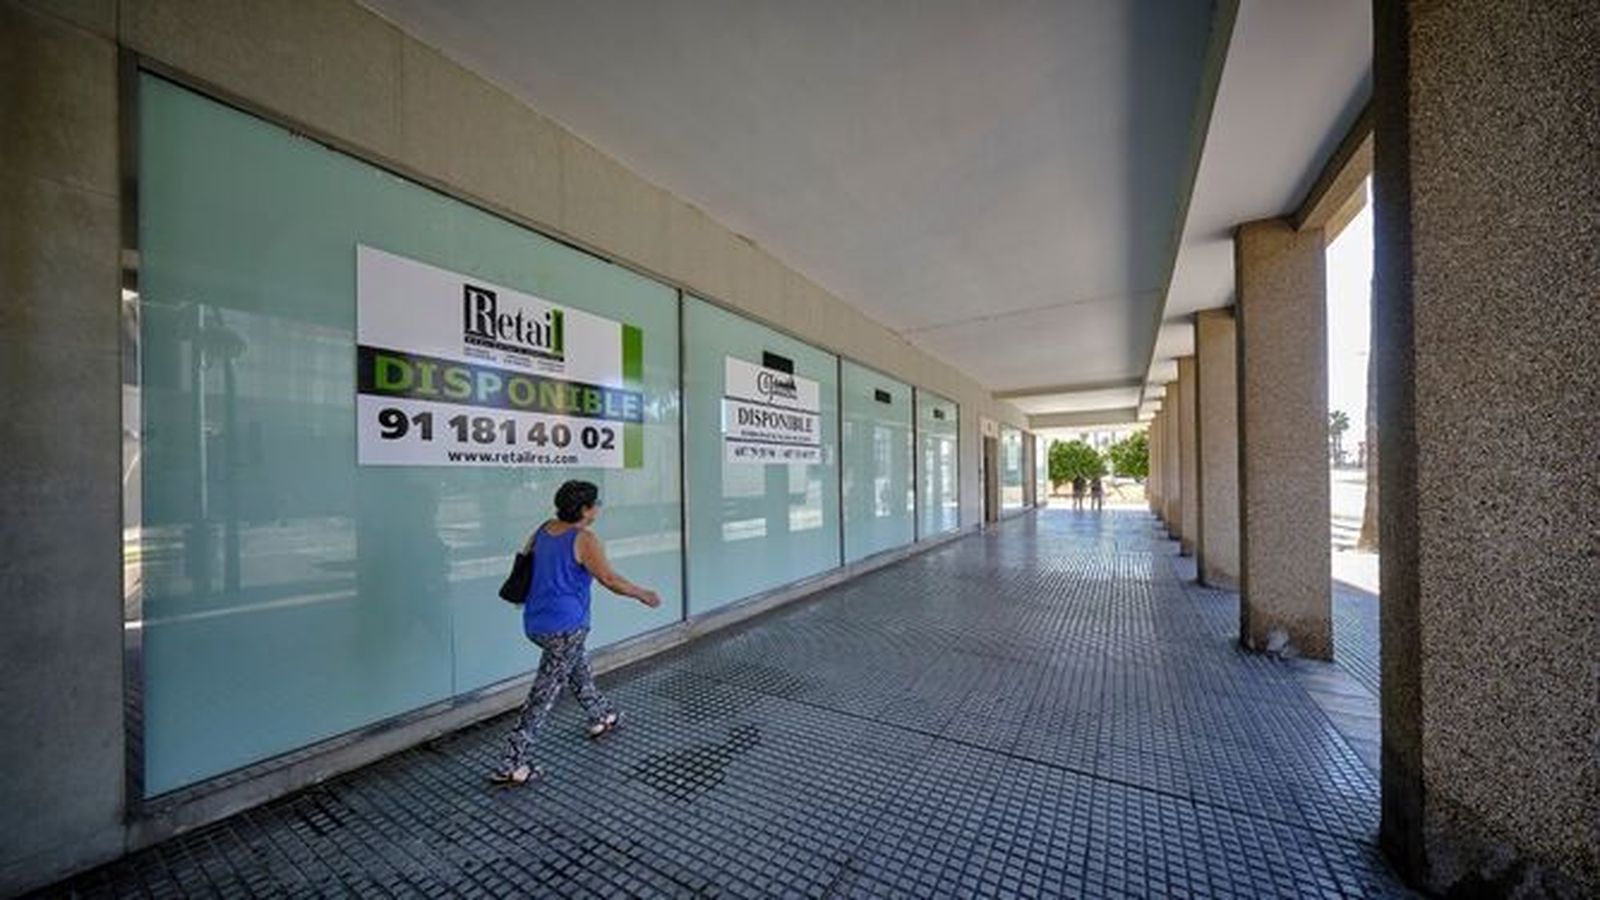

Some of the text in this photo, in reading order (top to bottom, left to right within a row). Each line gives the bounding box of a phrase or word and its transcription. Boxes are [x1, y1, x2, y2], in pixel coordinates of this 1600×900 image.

[464, 284, 564, 355] Retail
[374, 354, 639, 419] DISPONIBLE
[378, 408, 615, 450] 91 181 40 02
[738, 407, 814, 433] DISPONIBLE
[448, 450, 579, 465] www.retailres.com
